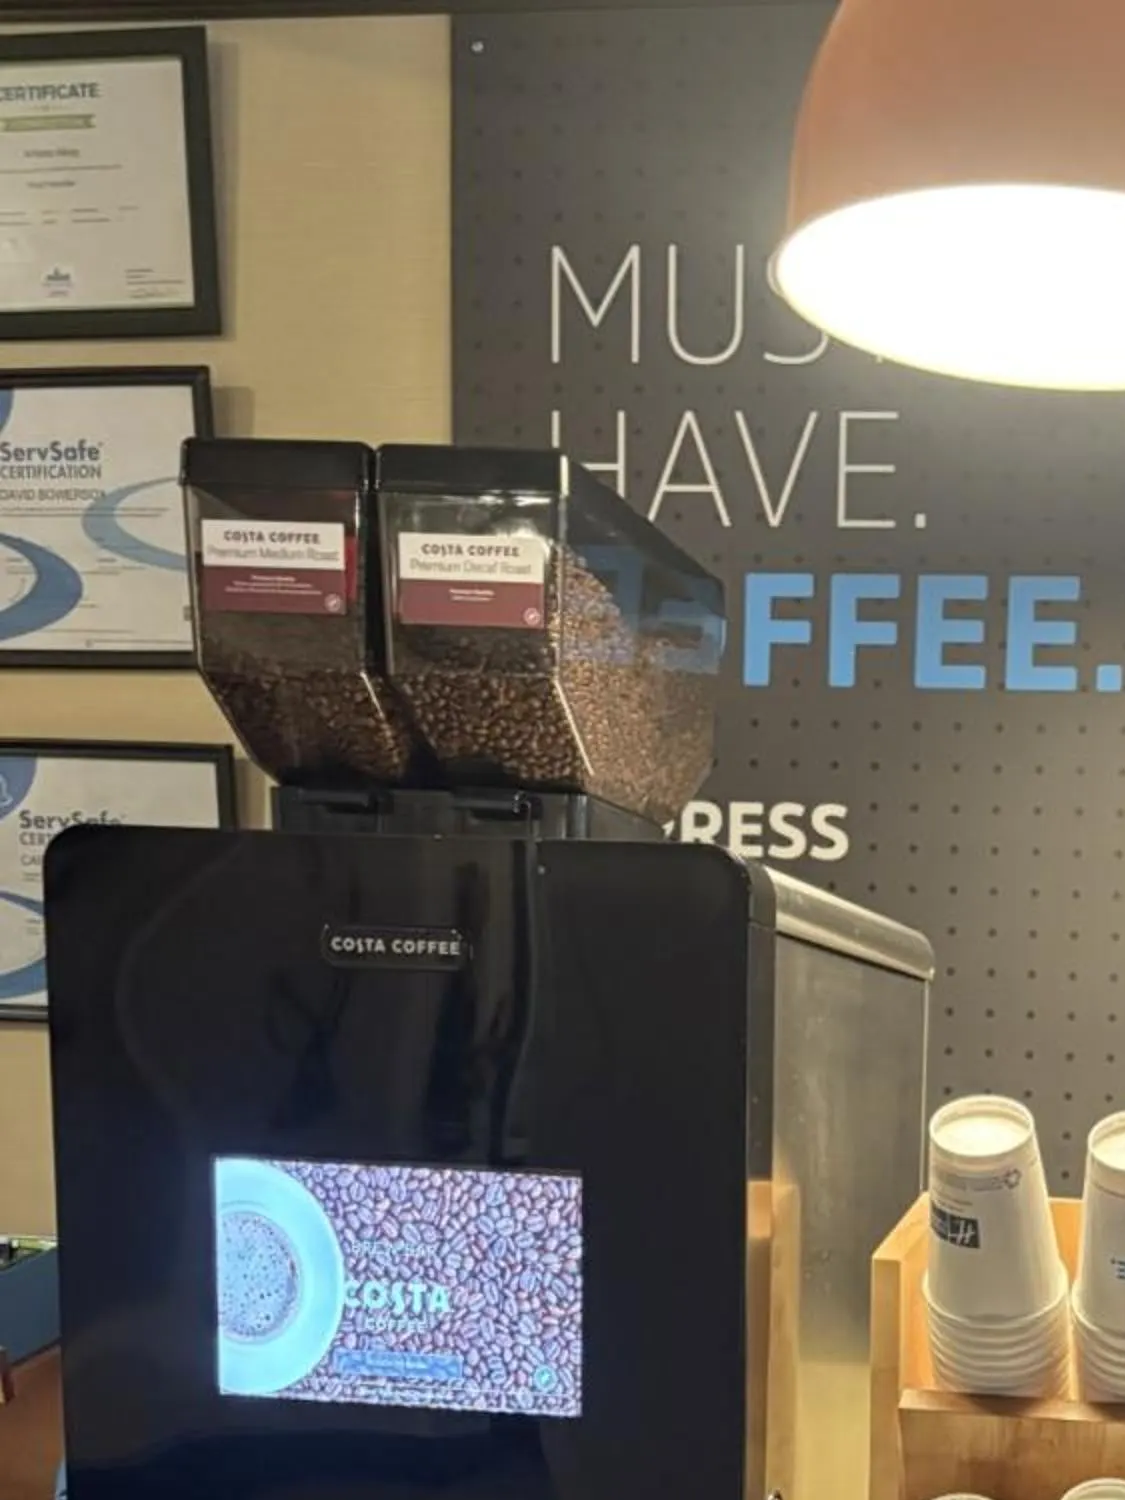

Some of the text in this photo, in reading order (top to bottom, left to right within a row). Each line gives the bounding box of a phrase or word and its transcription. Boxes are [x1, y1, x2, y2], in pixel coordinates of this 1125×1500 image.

[551, 244, 883, 365] MU
[0, 440, 101, 462] ServSafe
[0, 464, 102, 480] CERTIFICATION
[224, 530, 321, 545] COSTA COFFEE
[421, 543, 521, 557] COSTA COFFEE
[742, 572, 1123, 692] FFEE.
[663, 800, 850, 862] RESS
[331, 936, 461, 956] COSTA COFFEE
[343, 1280, 453, 1315] COSTA
